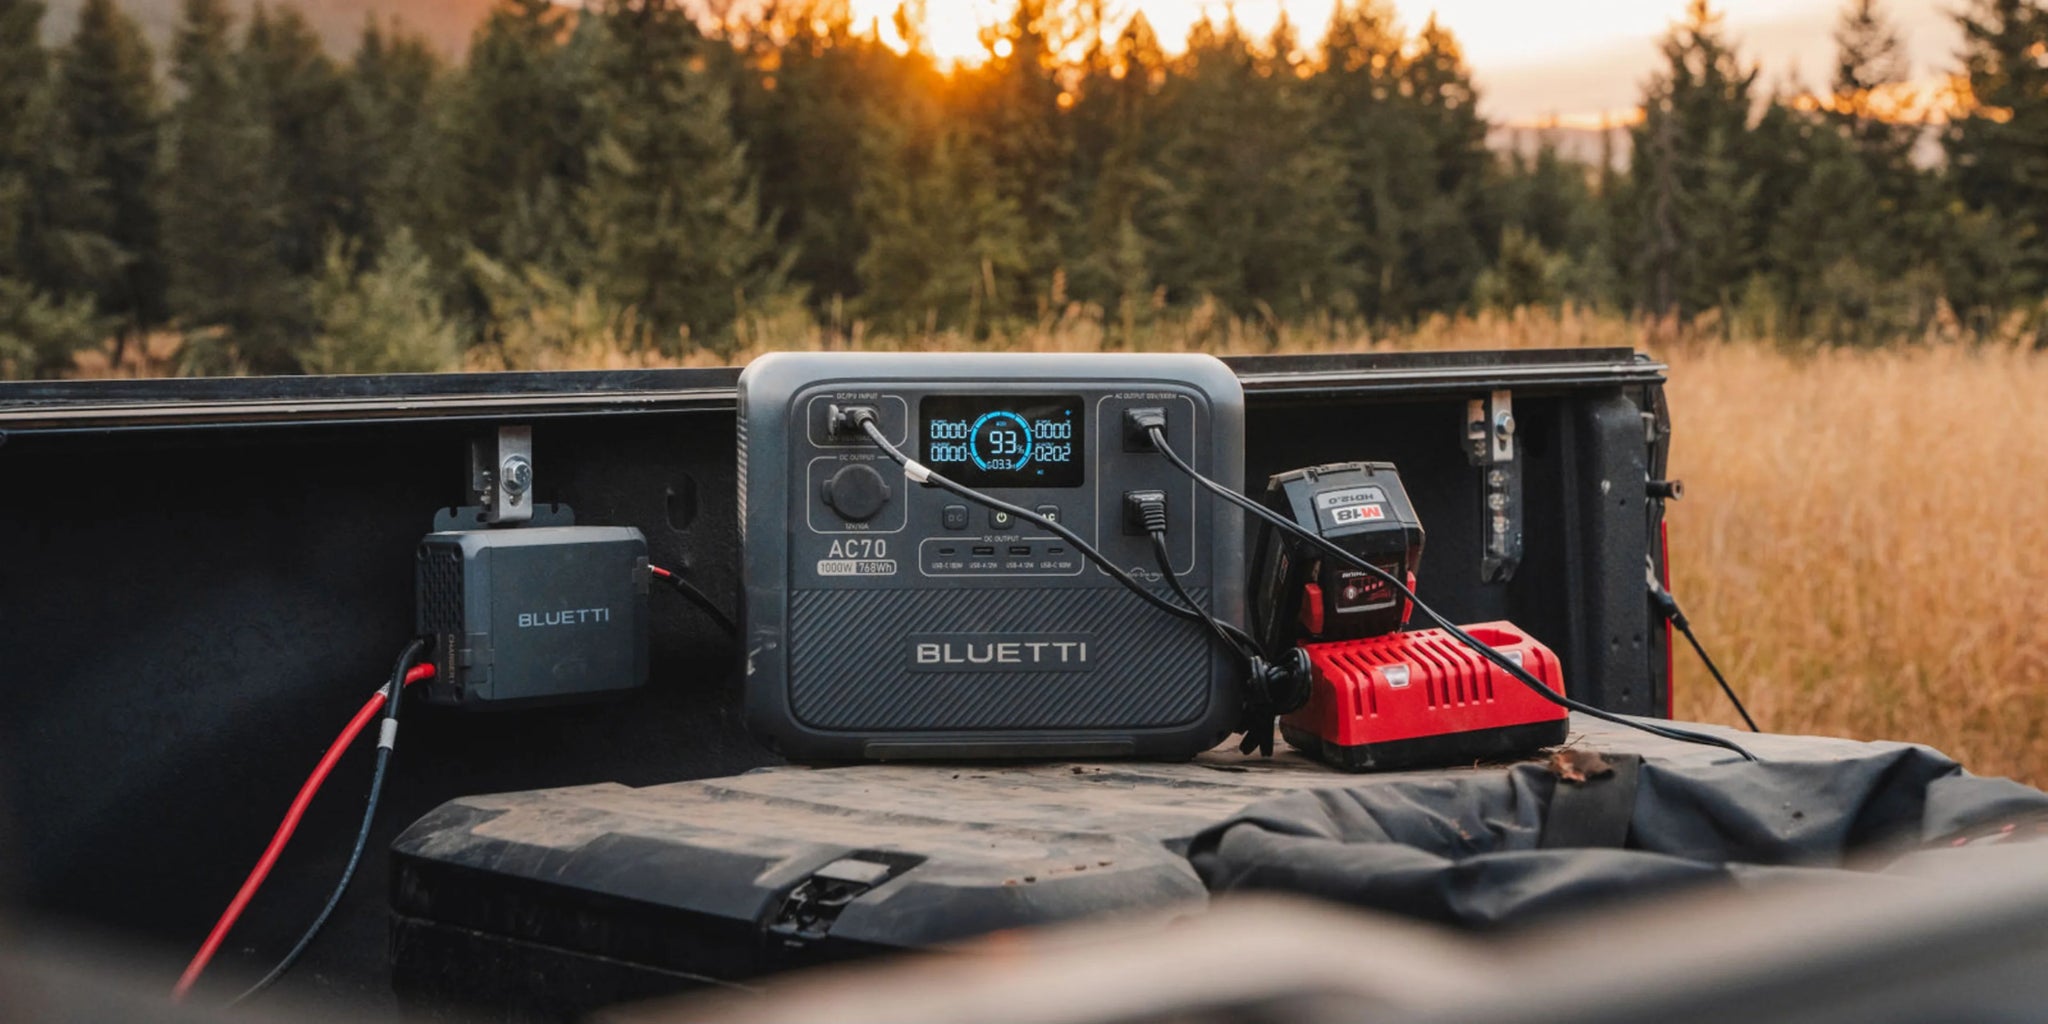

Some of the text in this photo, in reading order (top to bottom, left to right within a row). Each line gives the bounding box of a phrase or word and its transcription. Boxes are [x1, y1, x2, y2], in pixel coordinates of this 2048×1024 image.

[930, 422, 967, 439] 0000
[1035, 422, 1071, 439] 0000
[930, 445, 967, 462] 0000
[1035, 445, 1071, 462] 0202
[1328, 493, 1374, 505] HD12.0
[1336, 506, 1381, 521] M18
[994, 535, 1020, 543] OUTPUT
[828, 539, 887, 558] AC70
[821, 562, 892, 573] 1000W 768Wh
[517, 608, 610, 627] BLUETTI
[917, 642, 1087, 664] BLUETTI
